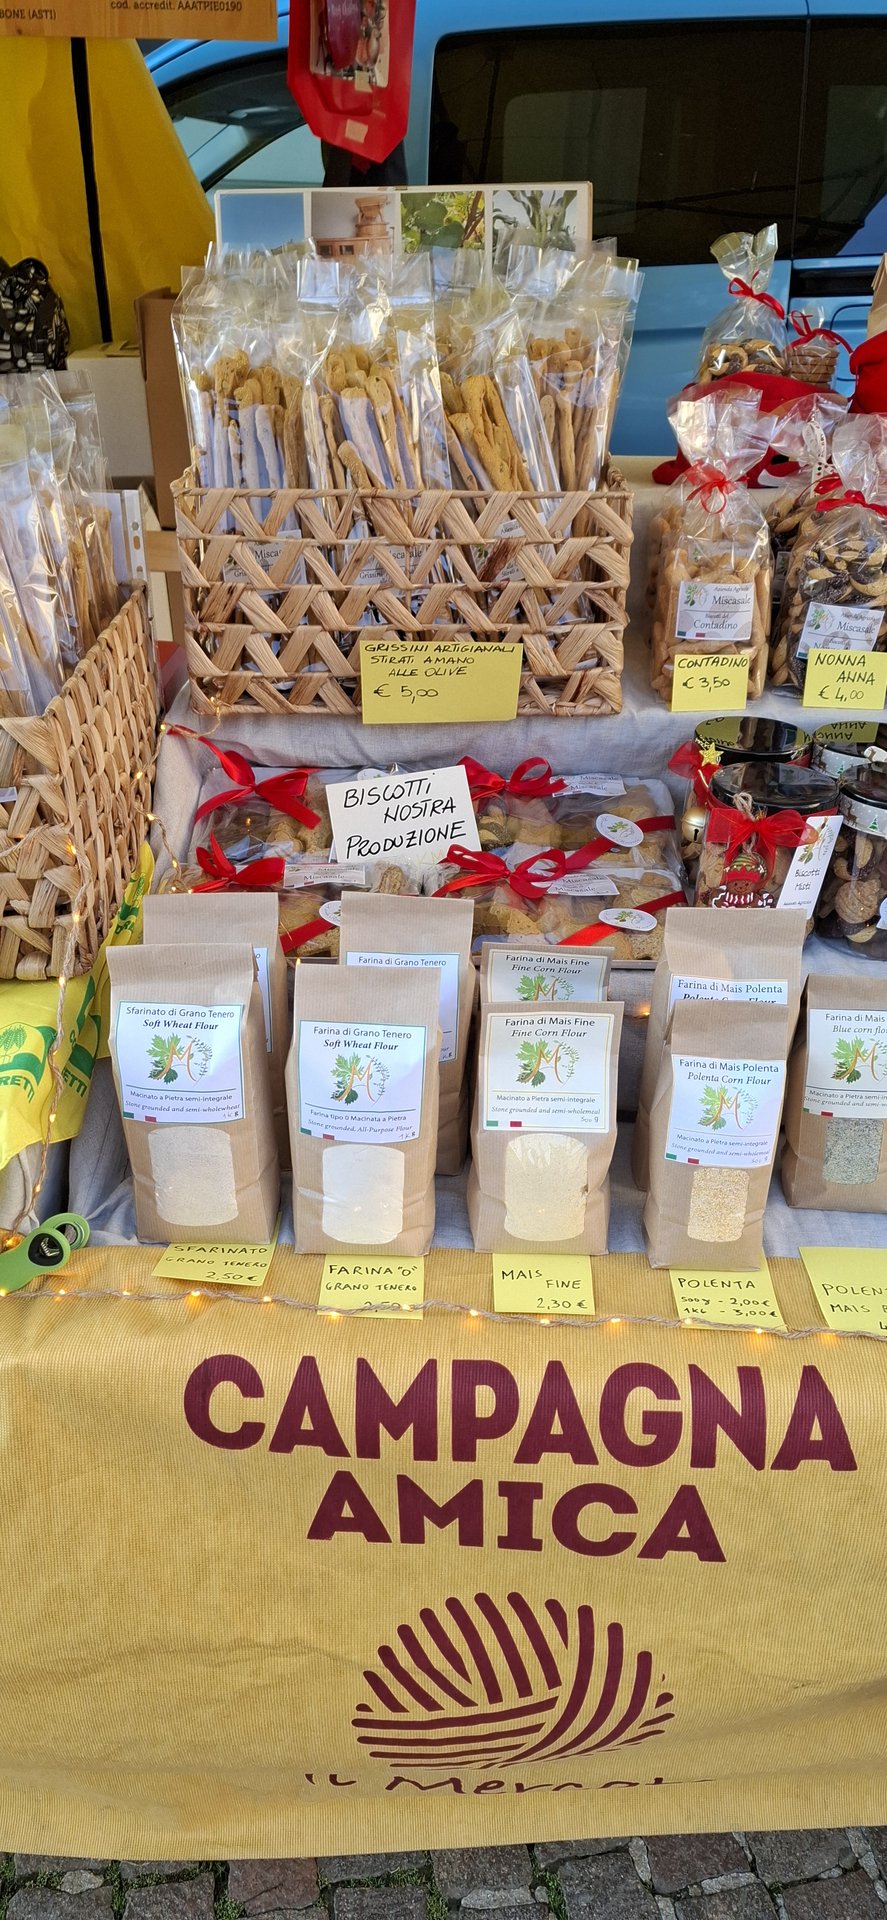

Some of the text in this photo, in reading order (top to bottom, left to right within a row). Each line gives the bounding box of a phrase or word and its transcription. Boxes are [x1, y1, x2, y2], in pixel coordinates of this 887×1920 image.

[28, 9, 57, 20] (ASTI)
[712, 594, 751, 605] Miscasale
[693, 619, 738, 630] Contadino
[836, 621, 876, 634] Miscasale
[364, 643, 515, 653] GRISSINI ARTIGIANALI
[370, 655, 414, 665] STIRATI
[677, 656, 748, 670] CONTADINO
[814, 653, 866, 667] NONNA
[388, 666, 468, 677] ALLE OLIVE
[836, 670, 876, 685] ANNA
[682, 676, 731, 693] € 3,50
[373, 683, 439, 704] € 5,00
[818, 685, 864, 702] € 4,00
[343, 777, 432, 809] BISCOTTI
[383, 796, 456, 824] NOSTRA
[346, 820, 467, 860] PRODUZIONE
[794, 868, 820, 878] Biscotti
[794, 881, 811, 891] Misti
[358, 956, 447, 967] Farina di Grano Tenero
[506, 954, 590, 967] Farina di Mais Fine
[511, 964, 531, 973] Fine
[558, 967, 583, 975] Flour
[677, 979, 783, 993] Farina di Mais Polenta
[126, 1007, 235, 1019] Sfarinato di Grano Tenero
[825, 1013, 886, 1023] Farina di Mais
[143, 1019, 219, 1030] Soft Wheat Flour
[505, 1016, 596, 1027] Farina di Mais Fine
[313, 1026, 412, 1039] Farina di Grano Tenero
[511, 1028, 588, 1038] Fine Corn Flour
[832, 1025, 873, 1034] Blue corn
[323, 1039, 399, 1051] Soft Wheat Flour
[679, 1059, 779, 1073] Farina di Mais Polenta
[687, 1072, 772, 1086] Polenta Corn Flour
[130, 1090, 158, 1100] Macinato
[496, 1094, 526, 1102] Macinato
[550, 1096, 596, 1104] semi-integrale
[809, 1090, 839, 1098] Macinato
[141, 1104, 170, 1112] grounded
[508, 1106, 538, 1114] grounded
[310, 1109, 329, 1119] Farina
[330, 1112, 344, 1121] tipo
[676, 1134, 705, 1143] Macinato
[710, 1138, 728, 1146] Pietra
[174, 1245, 268, 1254] SFARINATO
[165, 1256, 215, 1265] GRANO
[329, 1264, 393, 1275] FARINA
[501, 1269, 543, 1280] MAIS
[325, 1282, 369, 1291] GRANO
[545, 1279, 581, 1289] FINE
[677, 1277, 756, 1290] POLENTA
[536, 1297, 588, 1310] 2,30 €
[829, 1303, 871, 1313] MAIS
[183, 1353, 858, 1473] CAMPAGNA
[306, 1470, 727, 1563] AMICA
